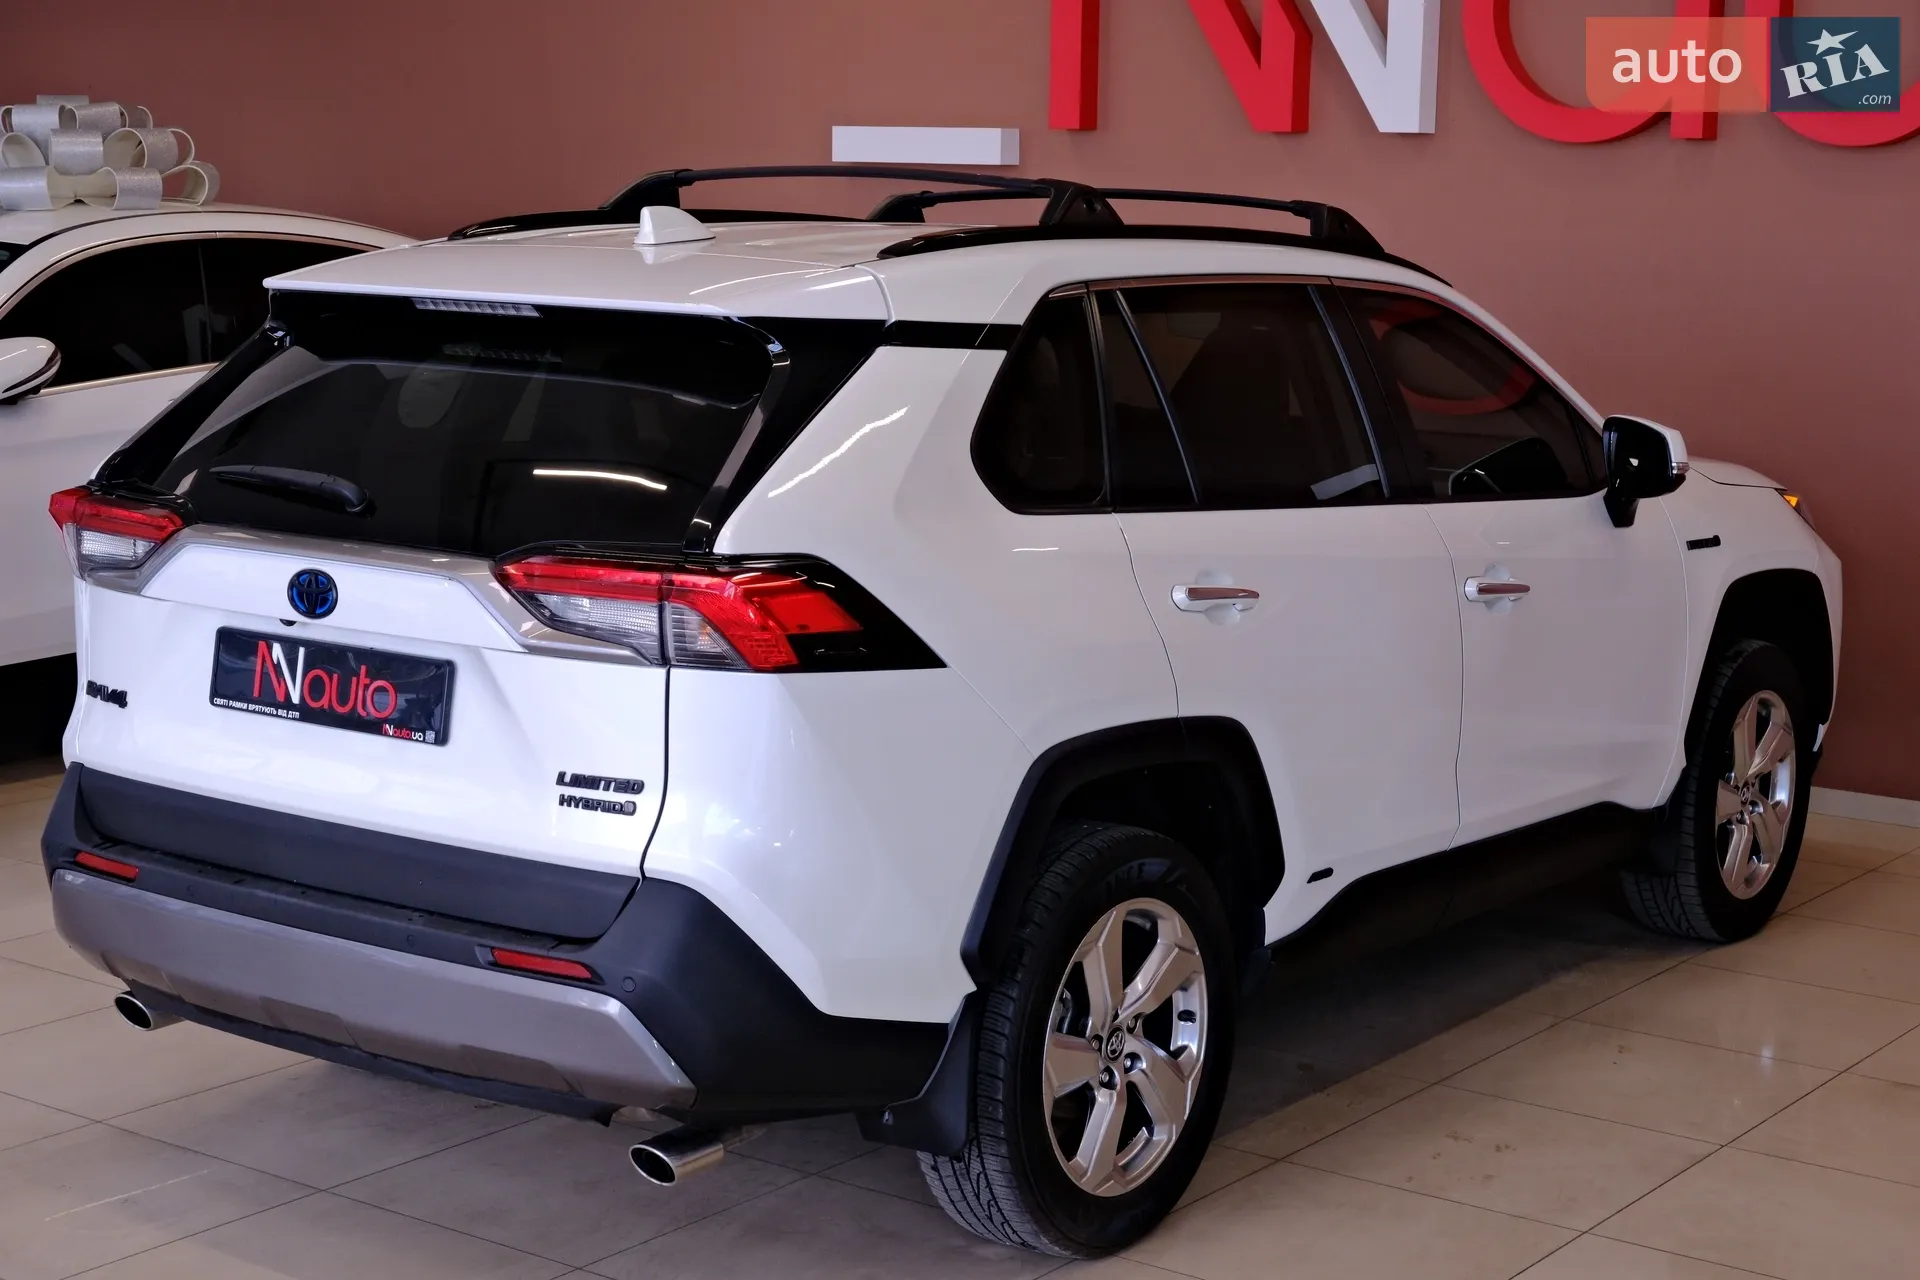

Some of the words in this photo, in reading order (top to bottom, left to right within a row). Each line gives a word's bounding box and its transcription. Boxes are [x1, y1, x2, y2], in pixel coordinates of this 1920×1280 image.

[213, 697, 228, 706] СВЯТІ
[228, 701, 248, 709] РАМКИ
[277, 709, 287, 717] ВІД
[556, 771, 645, 795] LIMITED
[559, 794, 625, 814] HYBRID
